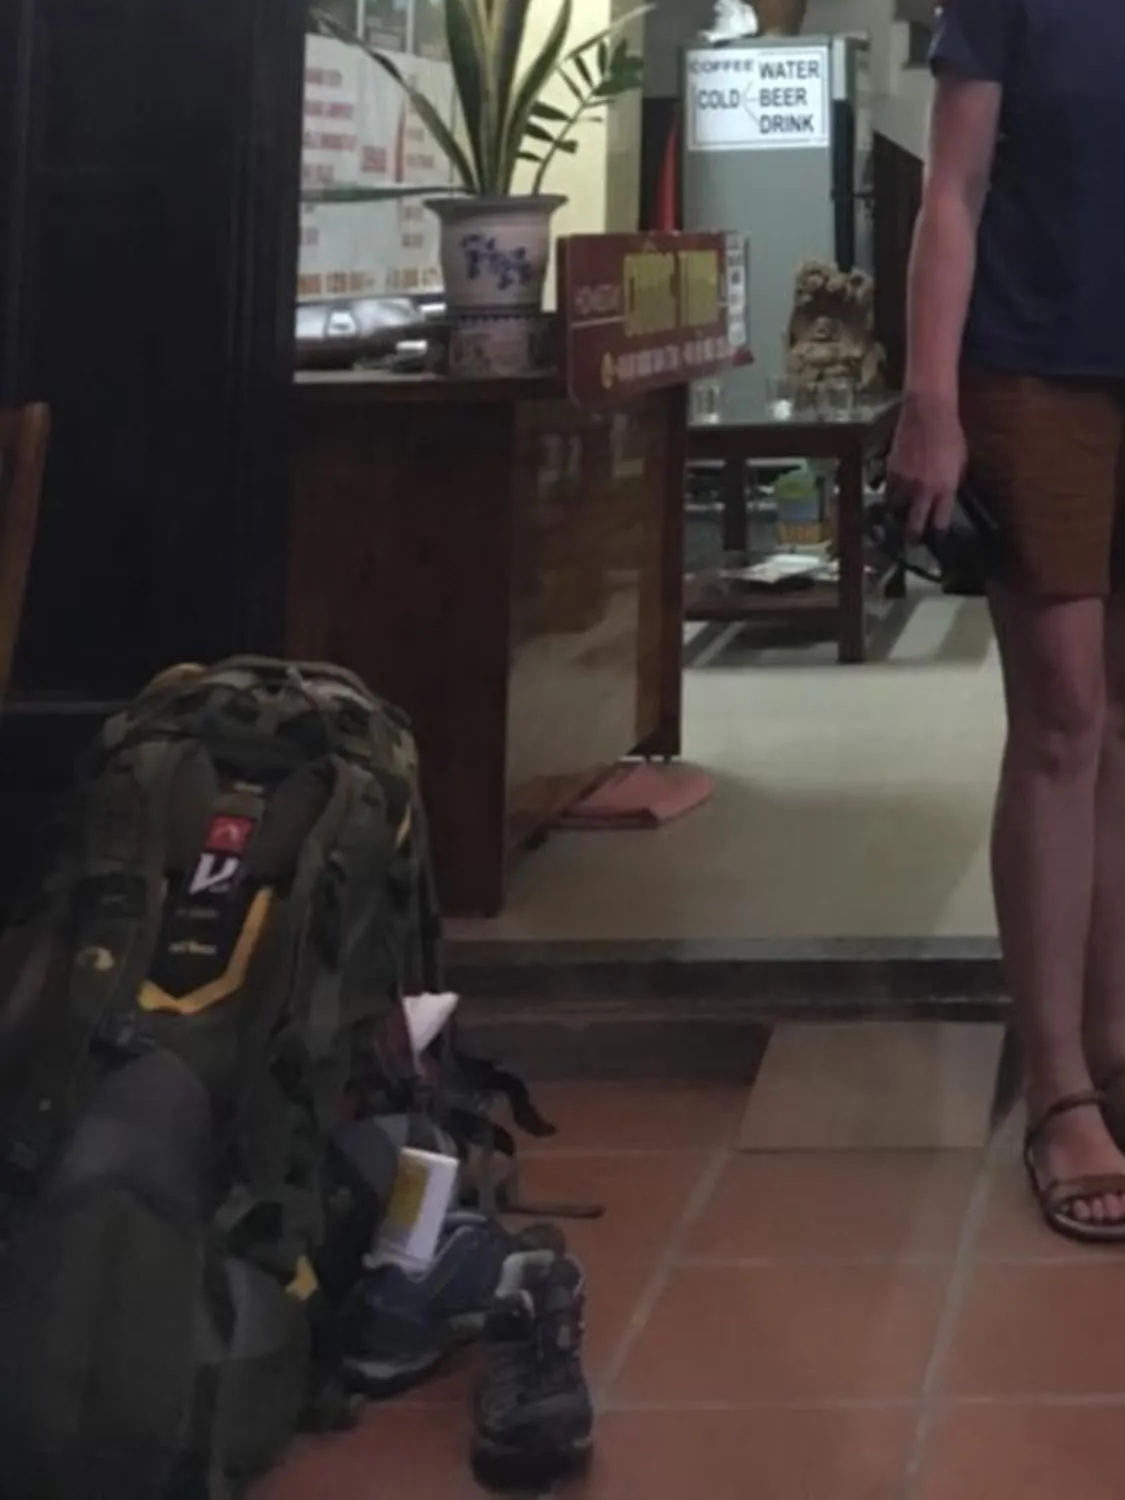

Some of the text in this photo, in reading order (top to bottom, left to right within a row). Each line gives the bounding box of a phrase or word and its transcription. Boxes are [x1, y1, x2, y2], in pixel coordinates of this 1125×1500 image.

[689, 59, 820, 79] COFFEE WATER
[699, 87, 808, 110] COLD BEER
[759, 114, 814, 134] DRINK
